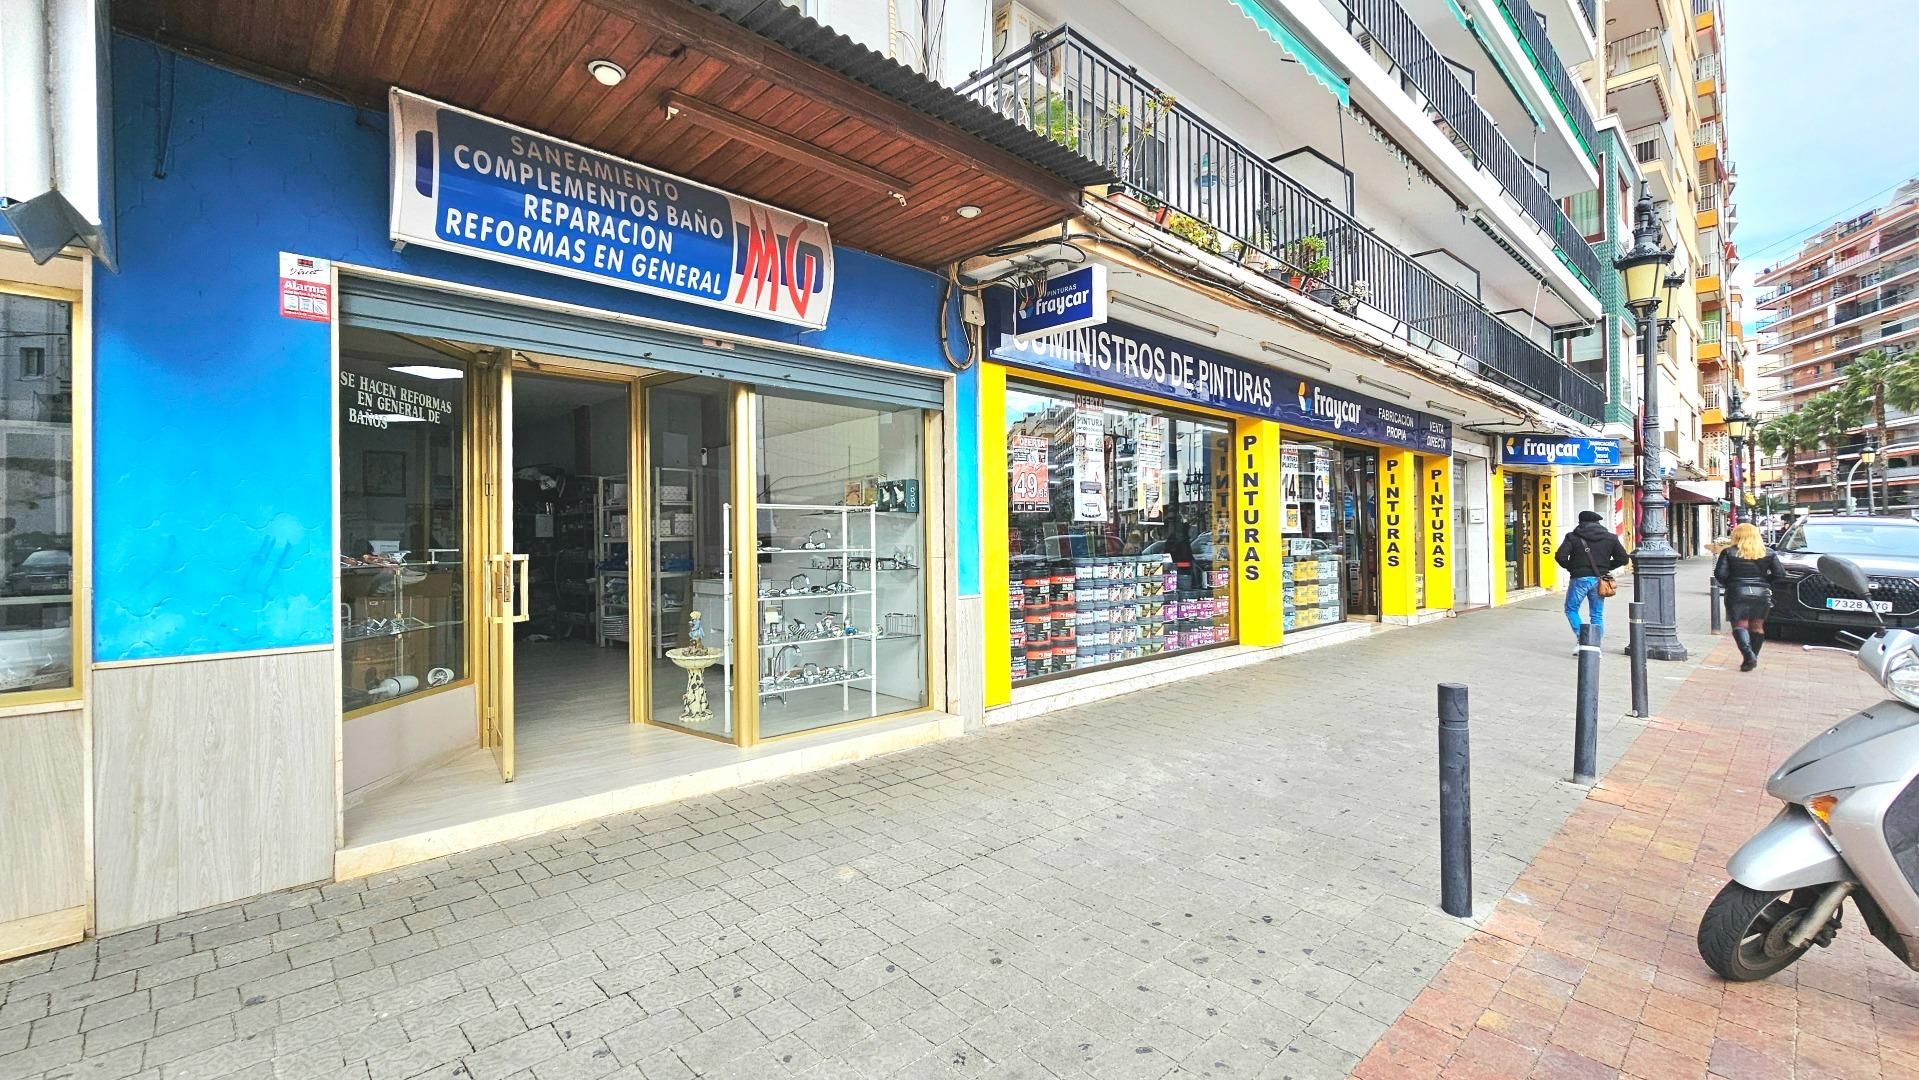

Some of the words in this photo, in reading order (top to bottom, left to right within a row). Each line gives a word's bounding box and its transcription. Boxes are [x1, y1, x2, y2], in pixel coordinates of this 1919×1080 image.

[511, 135, 679, 201] SANEAMIENTO
[453, 144, 659, 222] COMPLEMENTOS
[667, 200, 724, 239] BAÑO
[523, 194, 673, 255] REPARACION
[446, 207, 586, 264] REFORMAS
[594, 244, 622, 273] EN
[631, 251, 722, 296] GENERAL
[284, 280, 327, 294] Alarma
[1036, 289, 1089, 315] fraycar
[1046, 283, 1077, 297] PINTURAS
[340, 370, 355, 388] SE
[359, 375, 397, 399] HACEN
[400, 387, 452, 414] REFORMAS
[1170, 351, 1194, 390] DE
[1199, 358, 1272, 408] PINTURAS
[348, 407, 388, 430] BAÑOS
[357, 390, 373, 407] EN
[377, 396, 425, 420] GENERAL
[428, 409, 441, 424] DE
[1314, 386, 1361, 429] fraycar
[1378, 407, 1414, 428] FABRICACIÓN
[1386, 425, 1407, 441] PROPIA
[1429, 420, 1444, 434] VENTA
[1523, 438, 1580, 463] fraycar
[1014, 472, 1038, 498] 49
[1243, 435, 1260, 581] PINTURAS
[1386, 459, 1400, 568] PINTURAS
[1431, 469, 1445, 568] PINTURAS
[1541, 483, 1552, 555] PINTURAS
[1834, 600, 1863, 609] 7328
